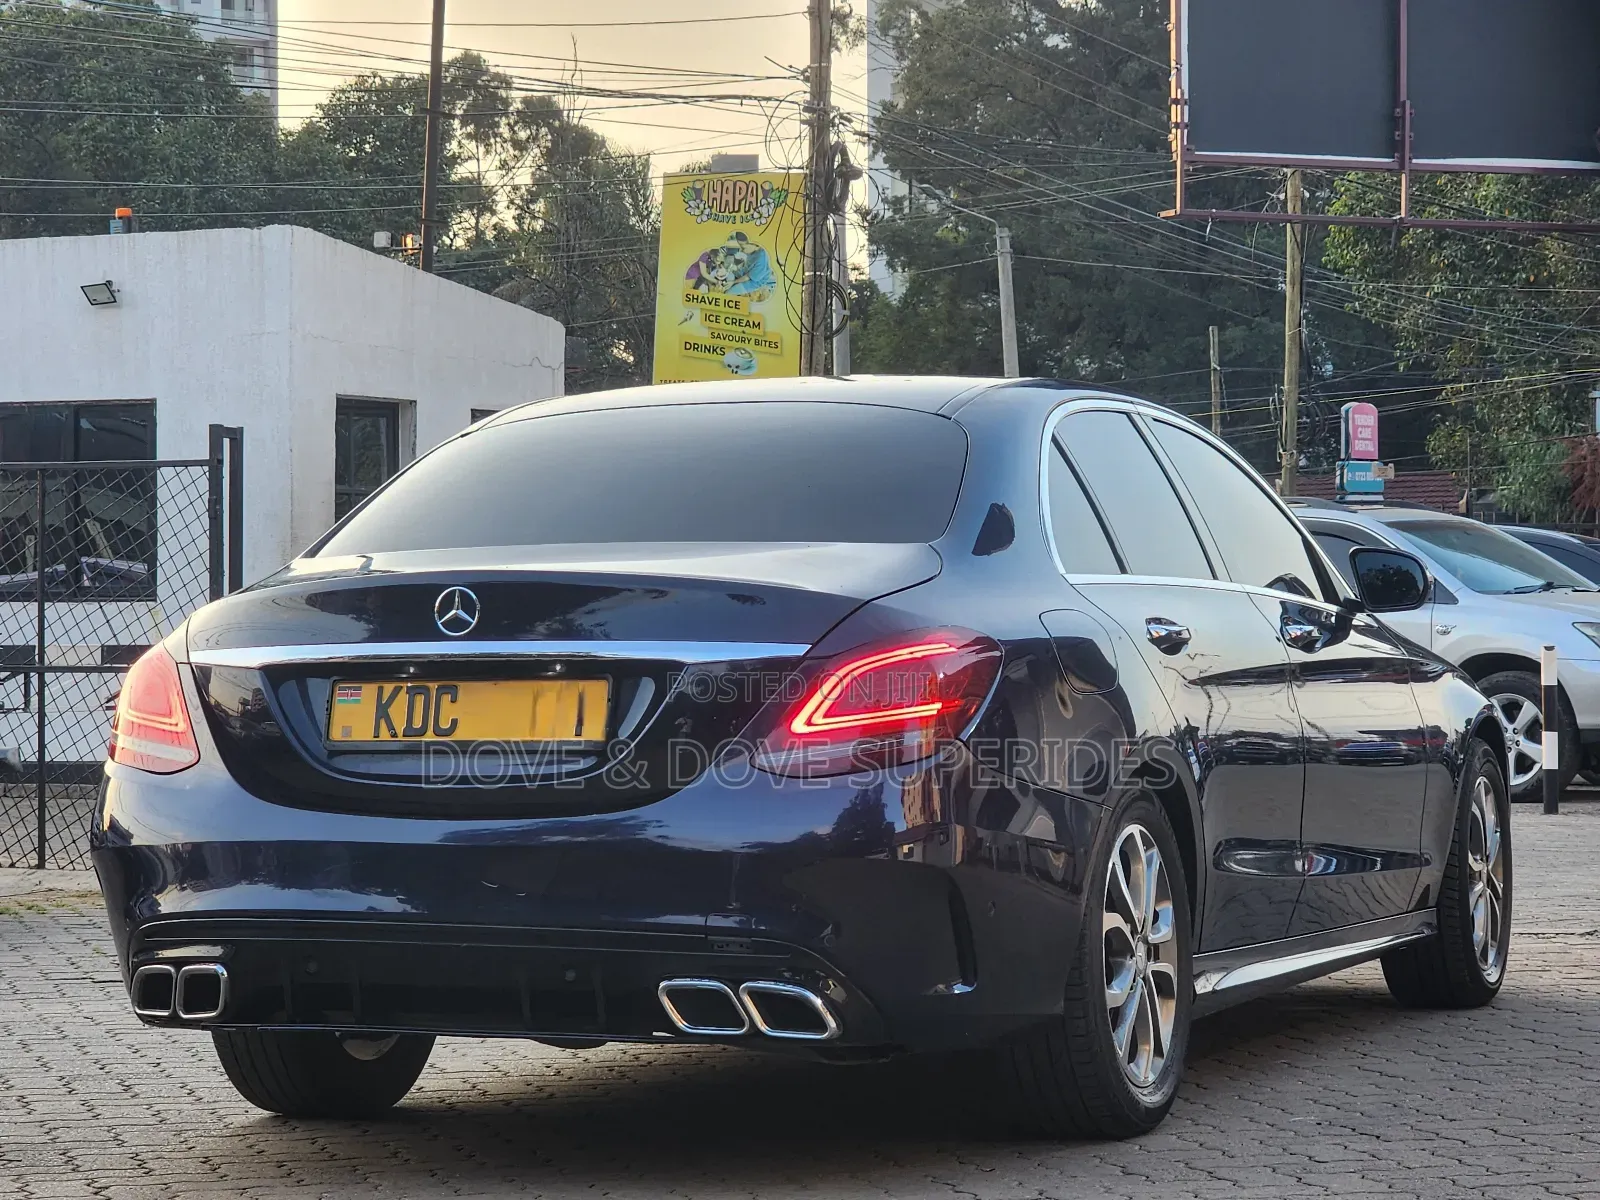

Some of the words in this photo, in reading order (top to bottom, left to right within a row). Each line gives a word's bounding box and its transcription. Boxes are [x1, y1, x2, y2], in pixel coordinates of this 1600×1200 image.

[708, 179, 759, 214] HAPA
[685, 293, 721, 307] SHAVE
[723, 298, 741, 310] ICE
[704, 313, 721, 324] ICE
[724, 316, 761, 330] CREAM
[684, 341, 726, 356] DRINKS
[710, 331, 752, 345] SAVOURY
[755, 338, 779, 349] BITES
[1354, 414, 1375, 426] TENDER
[1357, 427, 1373, 439] CARE
[1354, 440, 1375, 452] DENTAL
[373, 684, 460, 739] KDC
